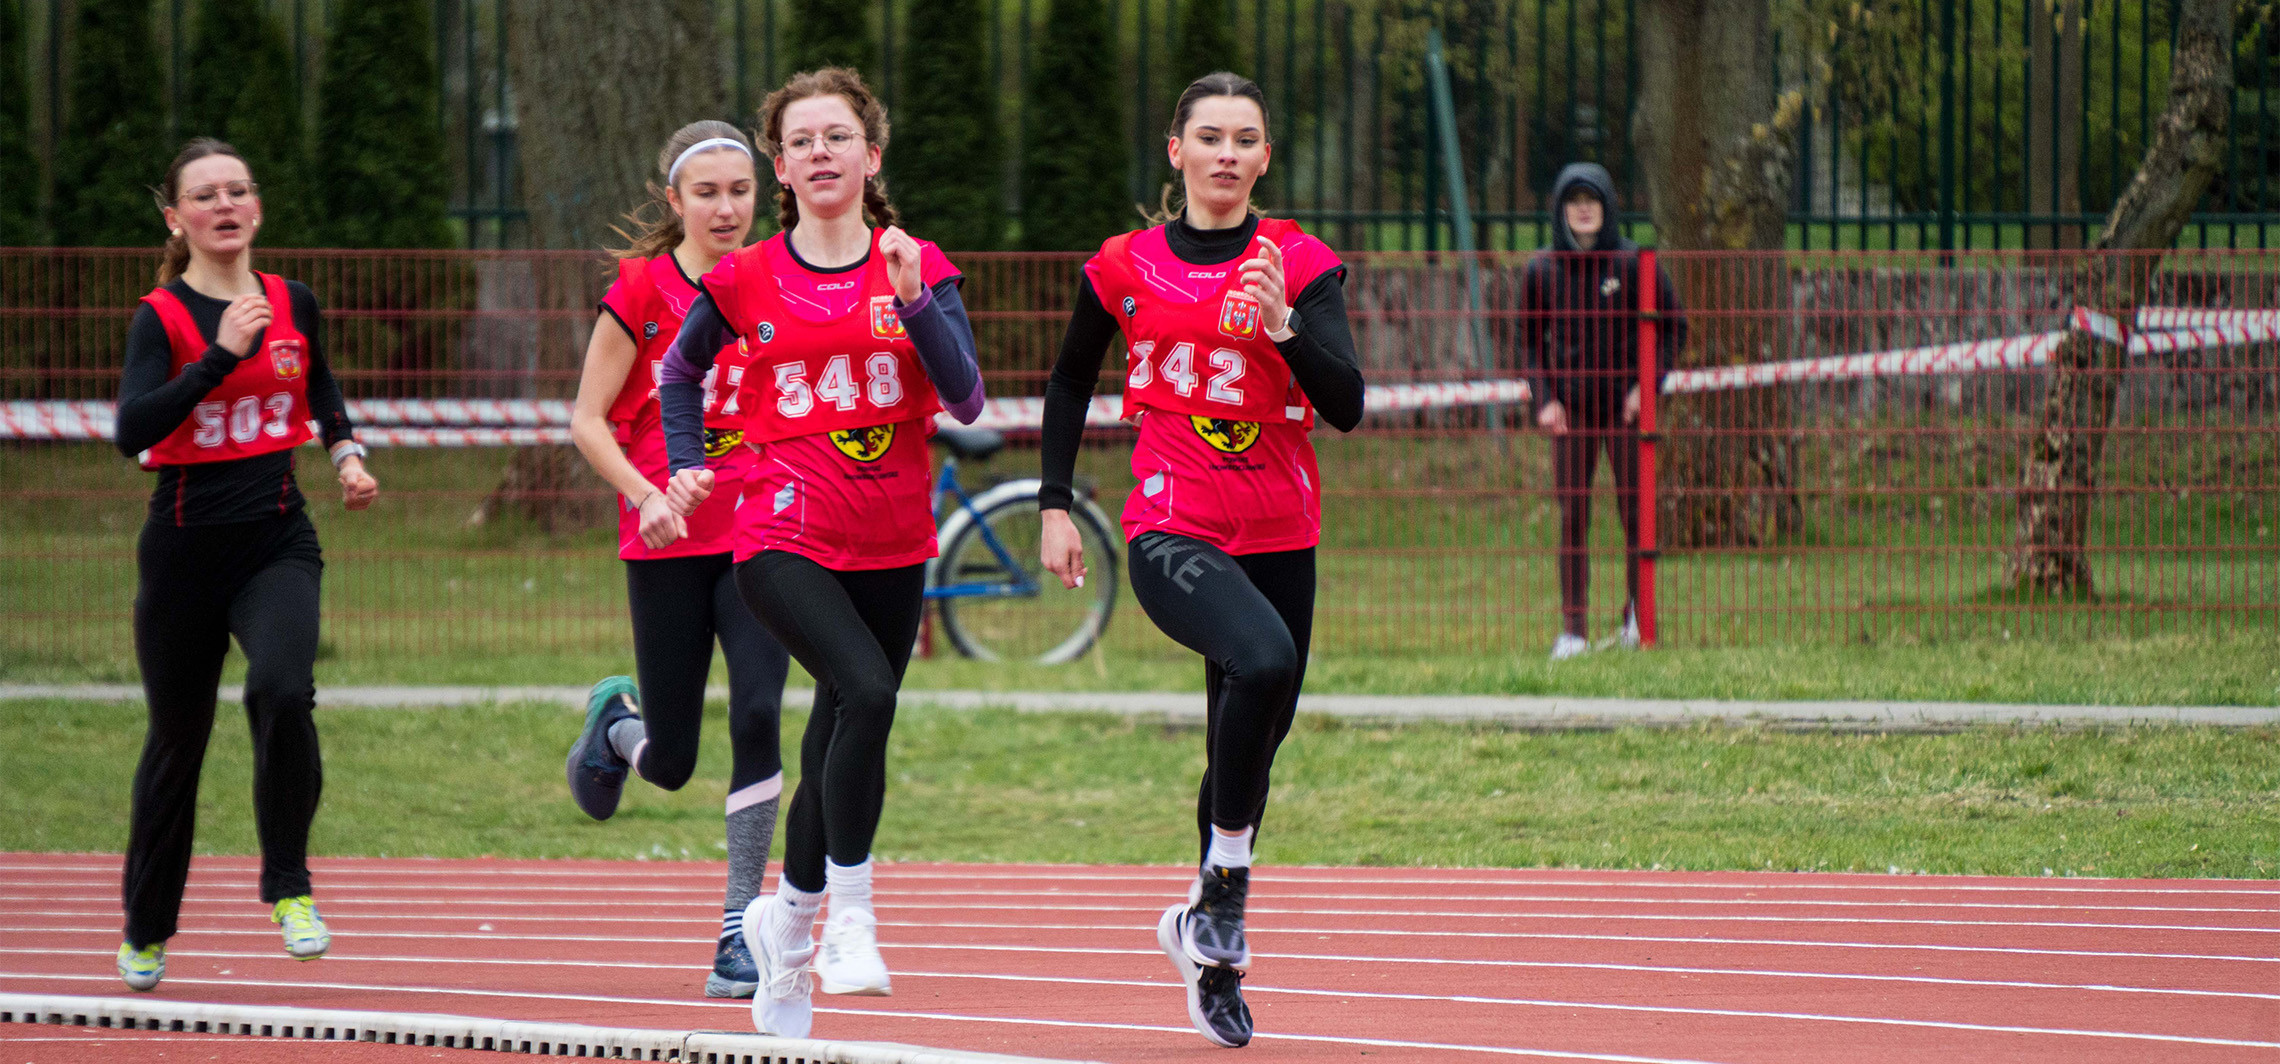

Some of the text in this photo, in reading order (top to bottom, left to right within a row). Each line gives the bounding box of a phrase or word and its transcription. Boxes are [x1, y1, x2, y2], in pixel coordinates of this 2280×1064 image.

[817, 281, 855, 291] COLO
[1188, 271, 1227, 279] COLO
[773, 352, 903, 418] 548
[193, 391, 294, 448] 503
